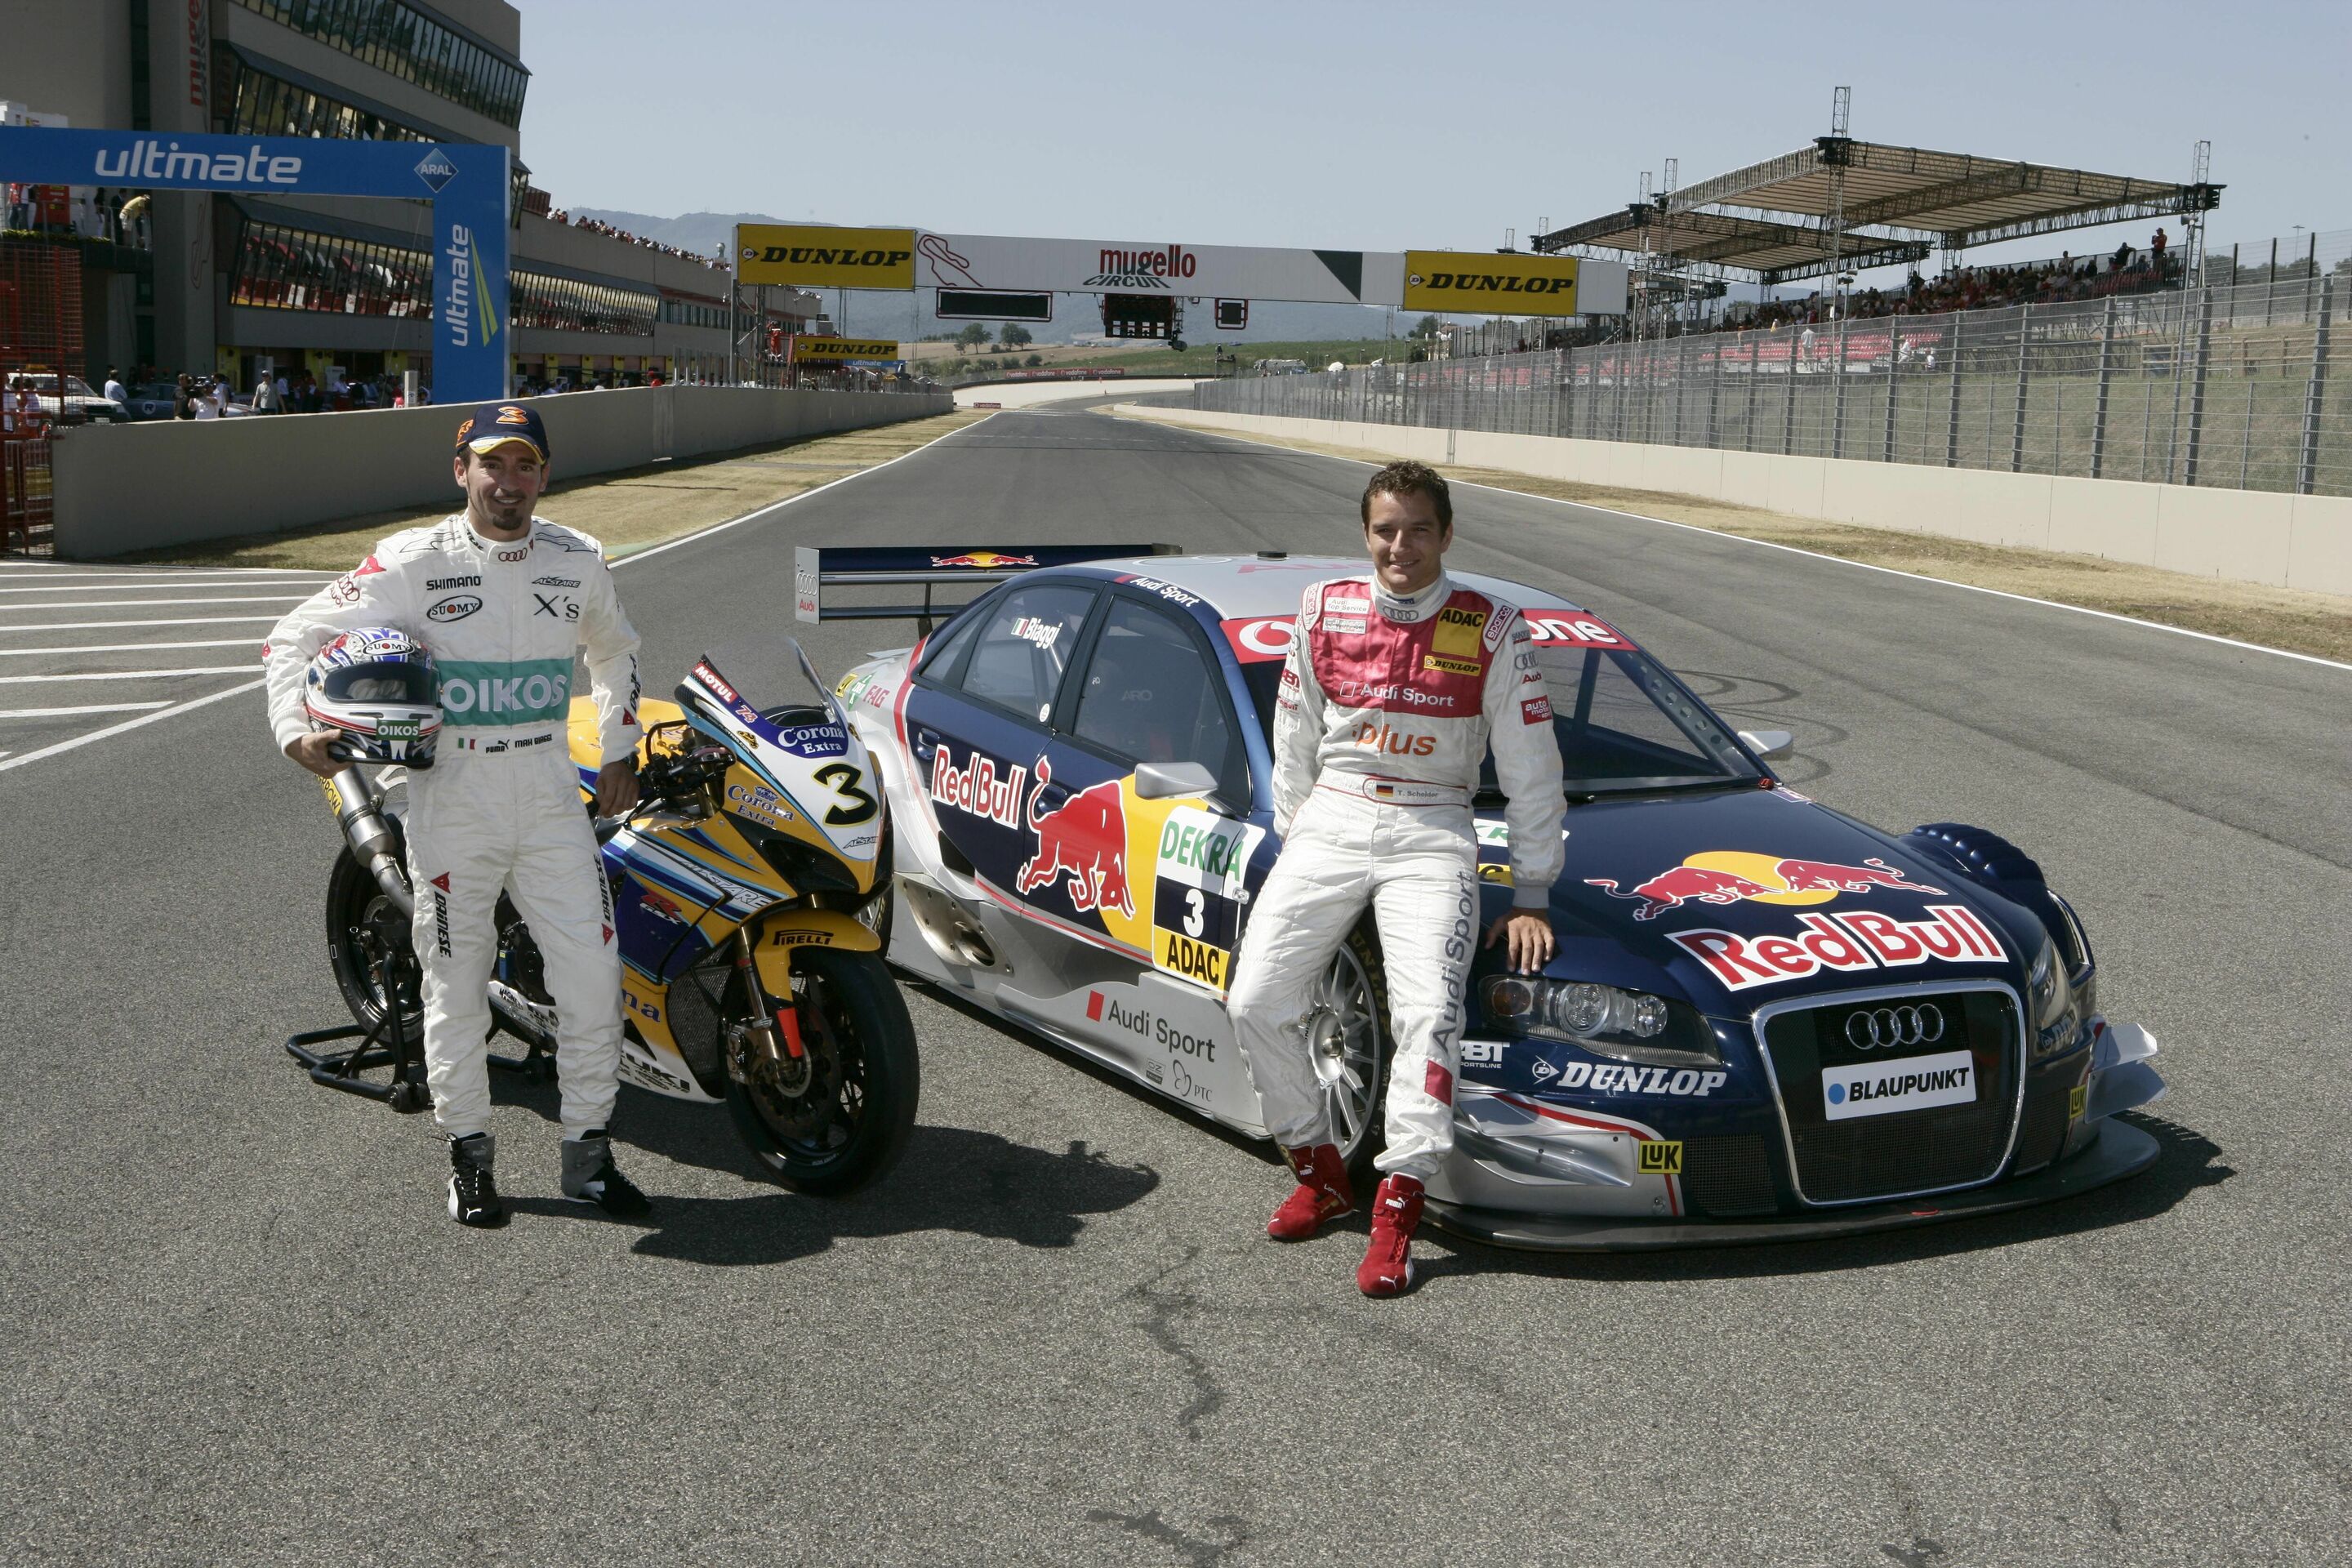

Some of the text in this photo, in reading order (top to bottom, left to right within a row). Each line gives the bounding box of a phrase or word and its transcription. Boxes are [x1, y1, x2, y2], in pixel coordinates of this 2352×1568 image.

[95, 140, 302, 184] ultimate
[420, 163, 452, 176] ARAL
[760, 247, 911, 267] DUNLOP
[1100, 245, 1196, 278] mugello
[446, 224, 470, 347] ultimate
[1083, 274, 1171, 289] CIRCUIT
[1427, 273, 1573, 294] DUNLOP
[812, 343, 897, 355] DUNLOP
[496, 406, 529, 425] 3
[426, 576, 482, 590] SHIMANO
[1130, 577, 1200, 608] Audi Sport
[800, 598, 815, 612] Audi
[1439, 608, 1484, 627] ADAC
[1022, 617, 1063, 649] Biaggi
[1487, 606, 1511, 639] sparco
[1434, 659, 1479, 673] DUNLOP
[443, 675, 568, 712] OIKOS
[695, 666, 733, 702] MOTUL
[862, 684, 890, 709] FAG
[1361, 684, 1454, 707] Audi Sport
[735, 705, 759, 724] 74
[1525, 700, 1548, 712] auto
[378, 724, 420, 737] OIKOS
[777, 725, 844, 747] Corona
[801, 743, 843, 754] Extra
[812, 763, 879, 827] 3
[933, 746, 1027, 827] Red Bull
[727, 785, 795, 822] Corona
[737, 804, 776, 826] Extra
[1160, 820, 1242, 881] DEKRA
[1183, 889, 1205, 938] 3
[773, 929, 834, 946] PIRELLI
[1670, 906, 2003, 986] Red Bull
[1166, 934, 1219, 986] ADAC
[1432, 871, 1473, 1053] Audi Sport
[1351, 932, 1390, 1035] UNLOP
[1107, 1000, 1216, 1063] Audi Sport
[1459, 1040, 1511, 1062] ABT
[1557, 1061, 1727, 1098] DUNLOP
[1849, 1067, 1970, 1102] BLAUPUNKT
[1194, 1085, 1213, 1102] PTC
